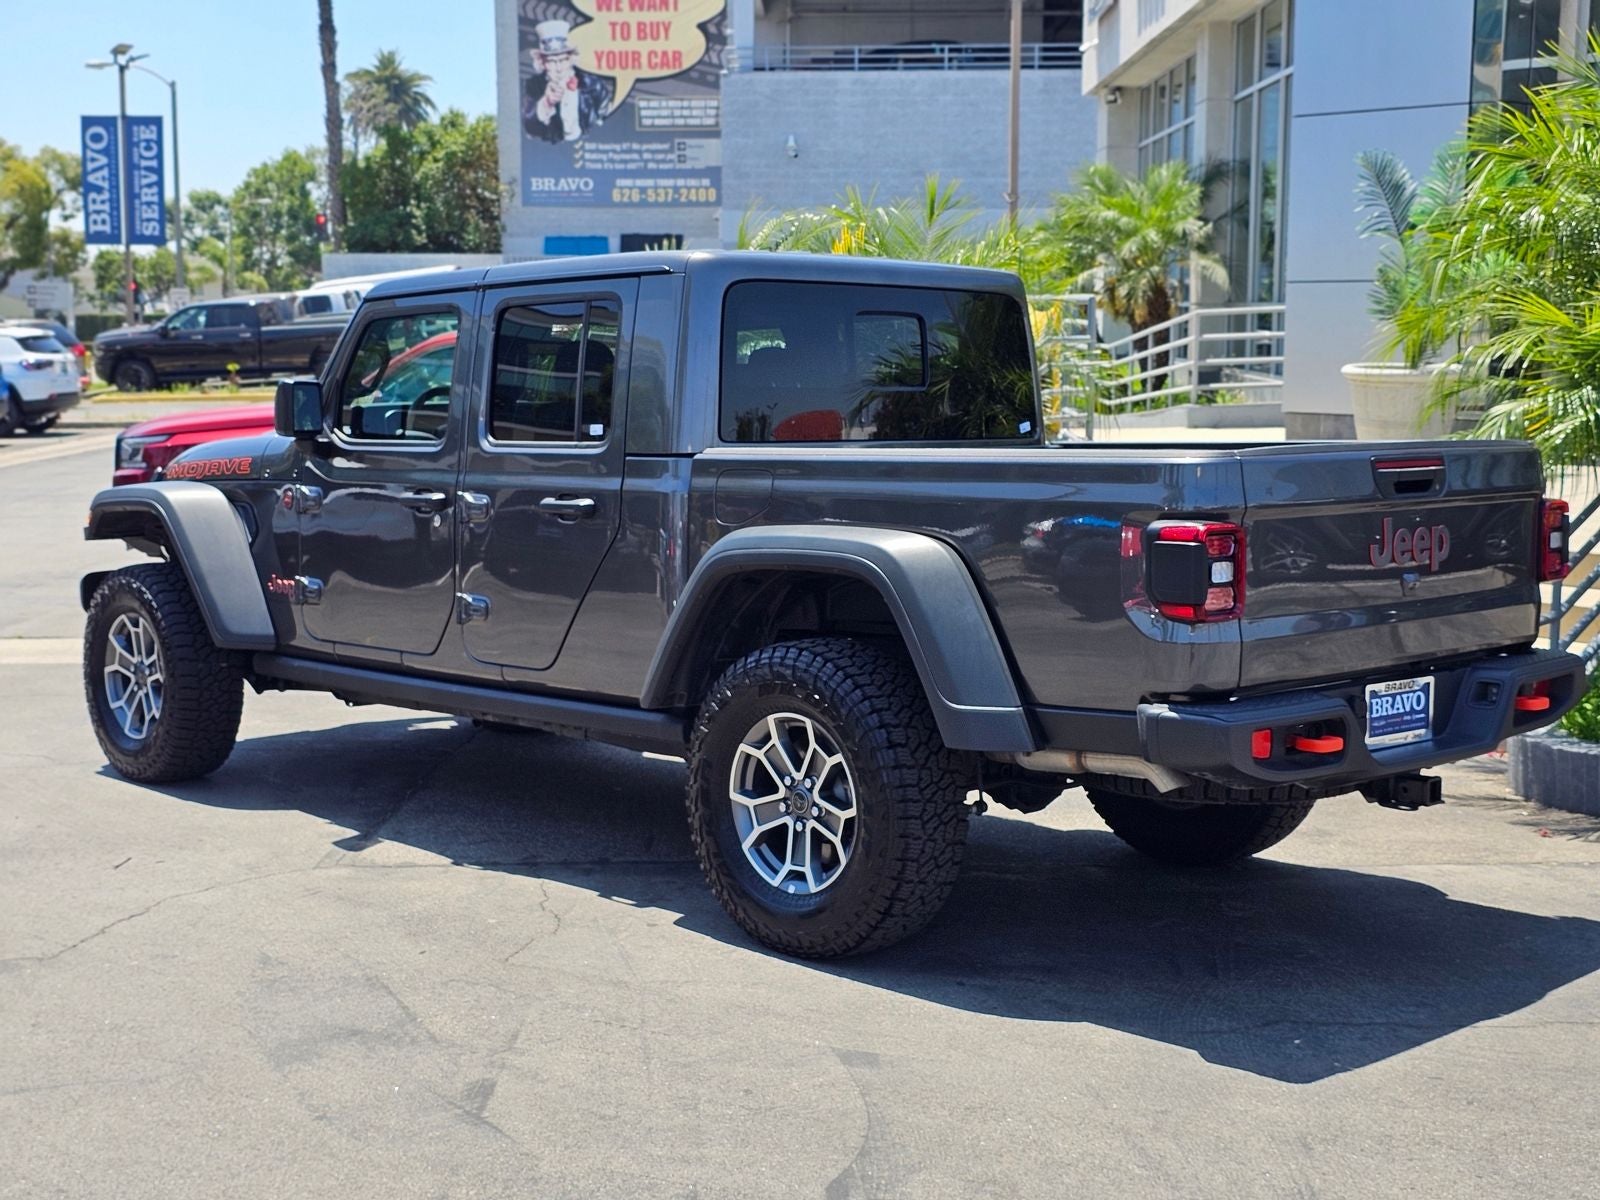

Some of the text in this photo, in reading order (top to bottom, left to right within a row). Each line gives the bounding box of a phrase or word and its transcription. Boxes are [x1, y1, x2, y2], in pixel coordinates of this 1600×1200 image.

[608, 21, 672, 41] TO BUY
[594, 50, 683, 70] YOUR CAR
[85, 125, 112, 235] BRAVO
[139, 124, 161, 236] SERVICE
[530, 177, 594, 192] BRAVO
[612, 188, 717, 203] 626-537-2400
[166, 457, 252, 479] MOJAVE
[1369, 516, 1450, 572] Jeep
[1384, 680, 1415, 692] BRAVO
[1371, 691, 1426, 718] BRAVO
